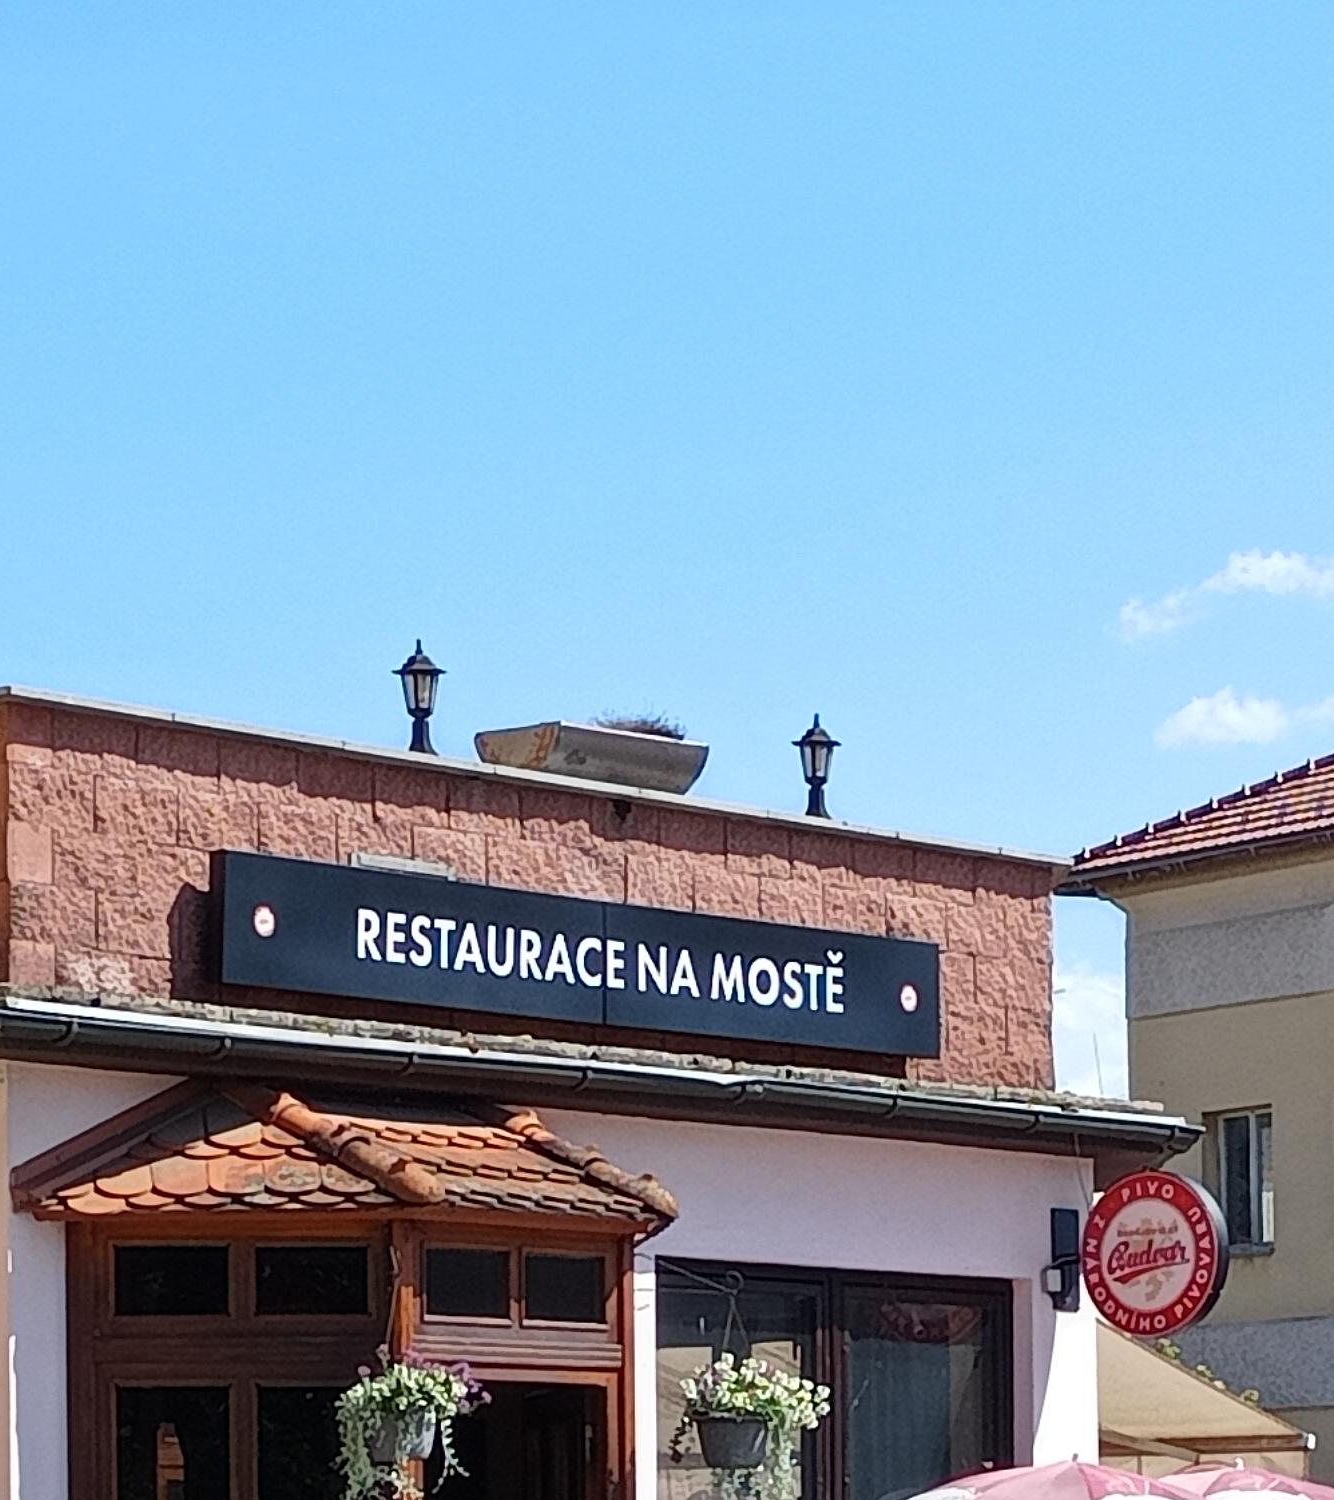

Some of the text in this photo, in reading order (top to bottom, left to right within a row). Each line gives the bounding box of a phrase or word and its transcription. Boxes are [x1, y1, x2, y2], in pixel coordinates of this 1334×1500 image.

[355, 908, 845, 1014] RESTAURACE NA MOSTĚ
[1121, 1181, 1175, 1202] PIVO
[1174, 1207, 1212, 1319] PIVOVARU
